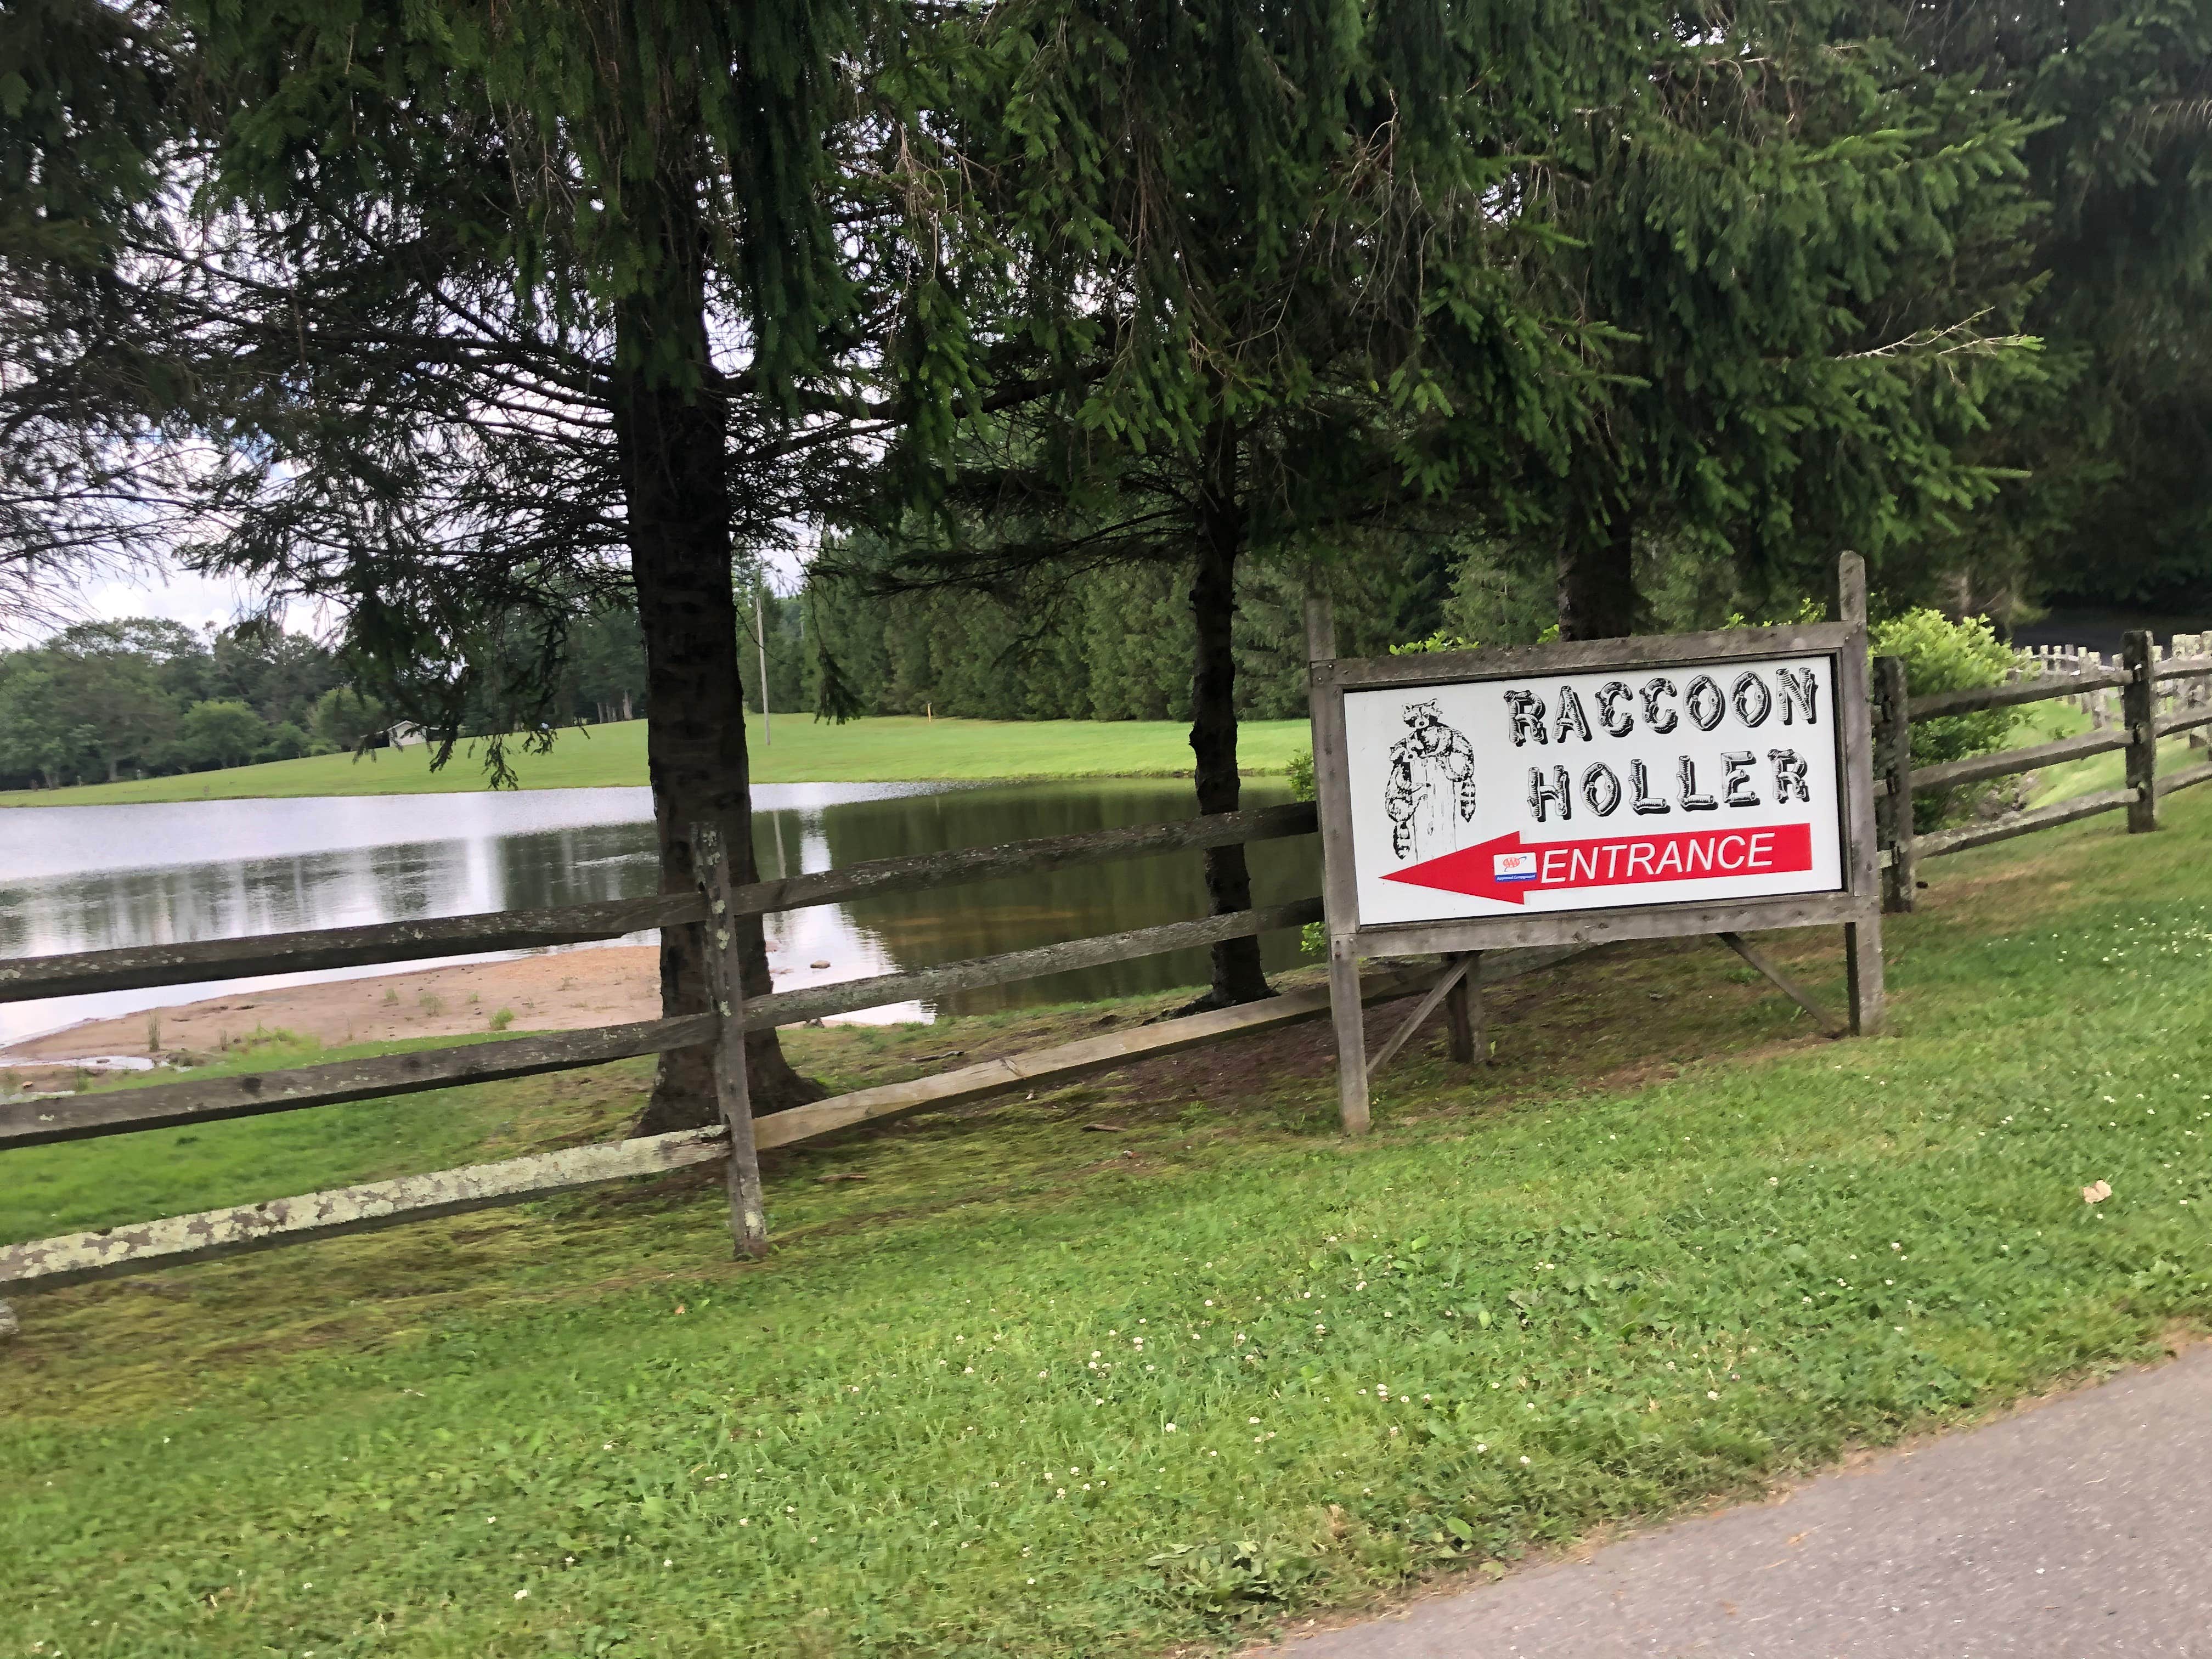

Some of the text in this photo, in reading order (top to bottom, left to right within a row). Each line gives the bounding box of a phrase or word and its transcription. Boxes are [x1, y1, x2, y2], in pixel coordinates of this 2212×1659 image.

[1503, 667, 1818, 747] RACCOON
[1527, 749, 1810, 822] HOLLER
[1504, 857, 1519, 867] AAA
[1541, 832, 1775, 883] ENTRANCE
